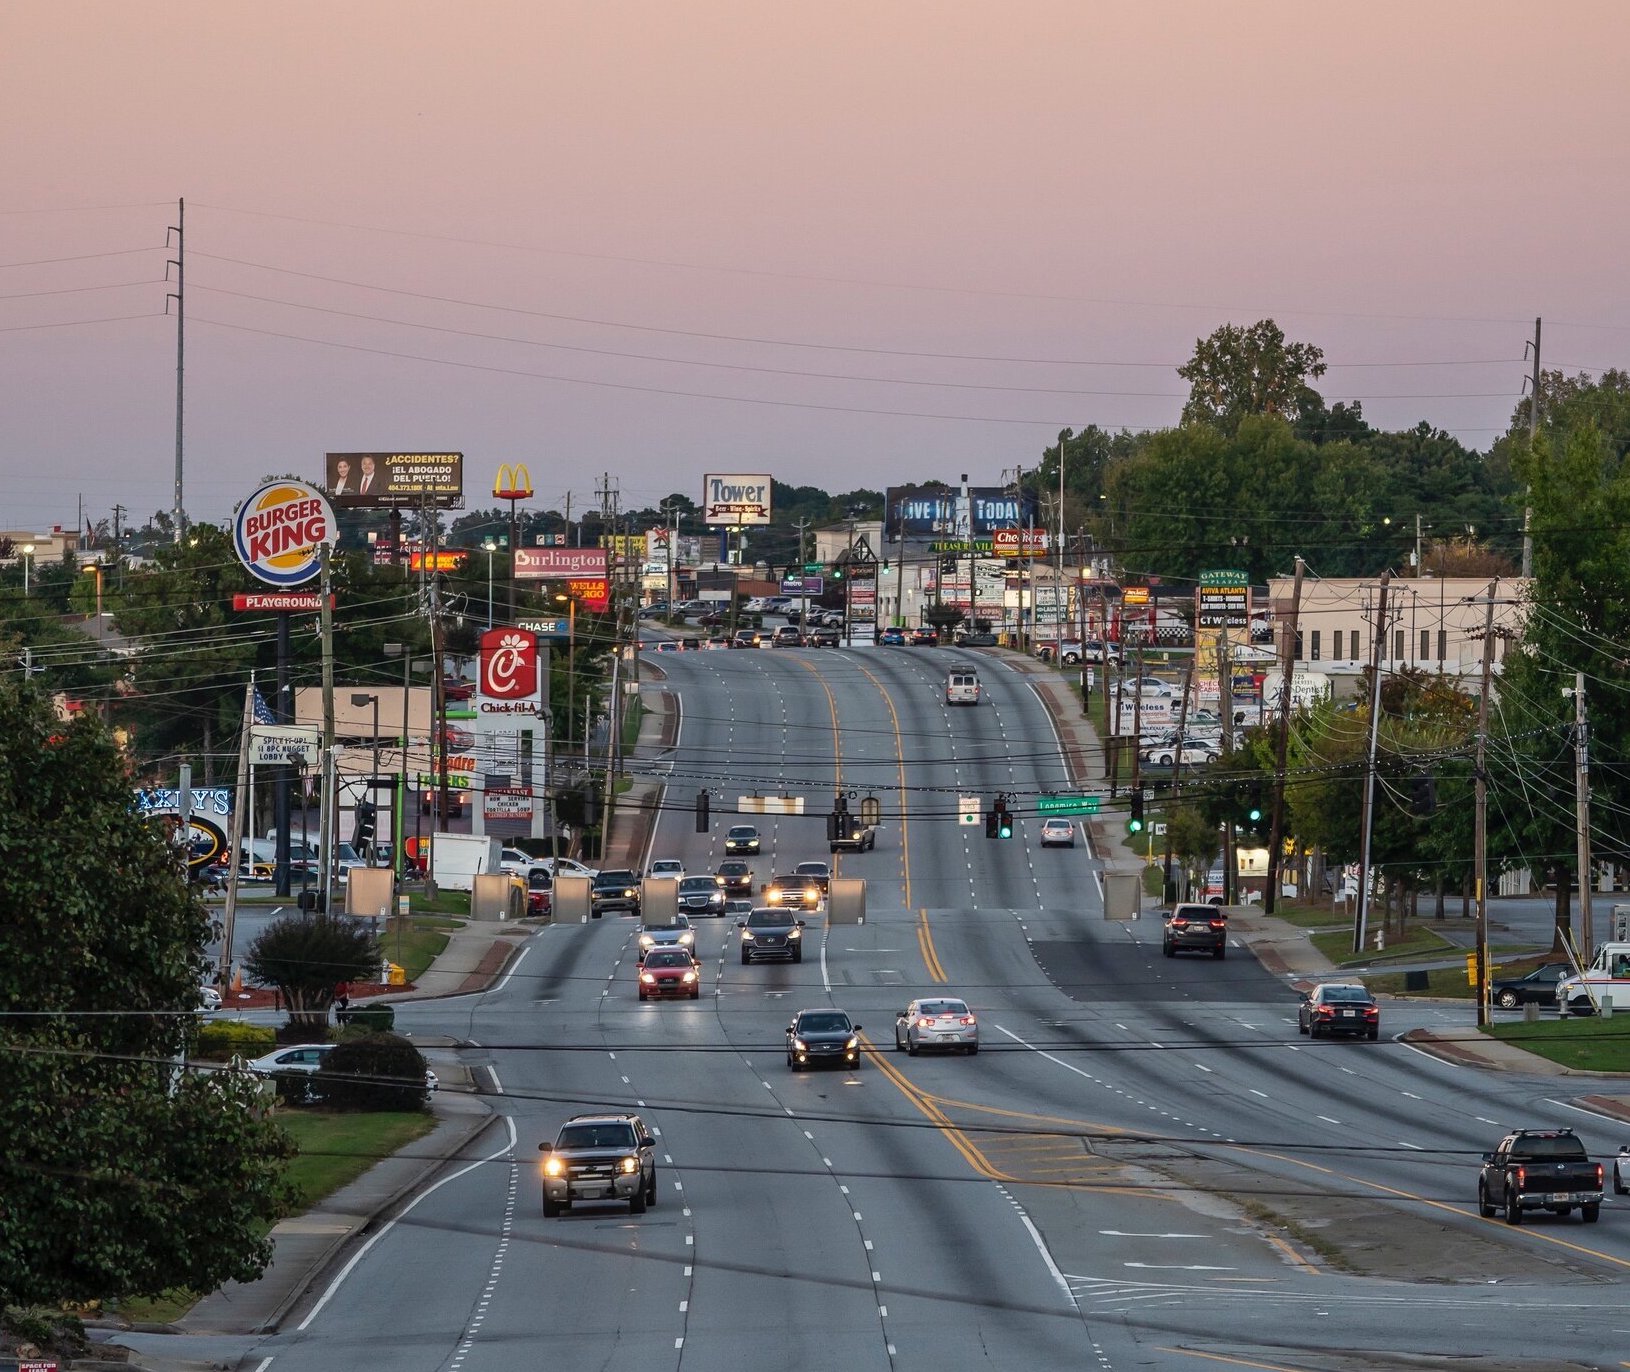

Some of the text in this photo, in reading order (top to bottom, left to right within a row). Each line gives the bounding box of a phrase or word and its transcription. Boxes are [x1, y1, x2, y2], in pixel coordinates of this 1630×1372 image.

[385, 455, 459, 465] ¿ACCIDENTES?
[392, 466, 452, 474] ¡EL ABOGADO
[393, 474, 414, 483] DEL
[710, 479, 765, 502] Tower
[246, 499, 322, 538] BURGER
[250, 517, 325, 563] KING
[514, 550, 606, 571] Burlington
[1201, 571, 1248, 580] GATEWAY
[570, 582, 604, 590] WELLS
[246, 597, 322, 607] PLAYGROUND
[1200, 616, 1211, 624] CT
[518, 622, 555, 631] CHASE
[481, 702, 536, 713] Chick-fil-A
[1081, 801, 1098, 812] Way
